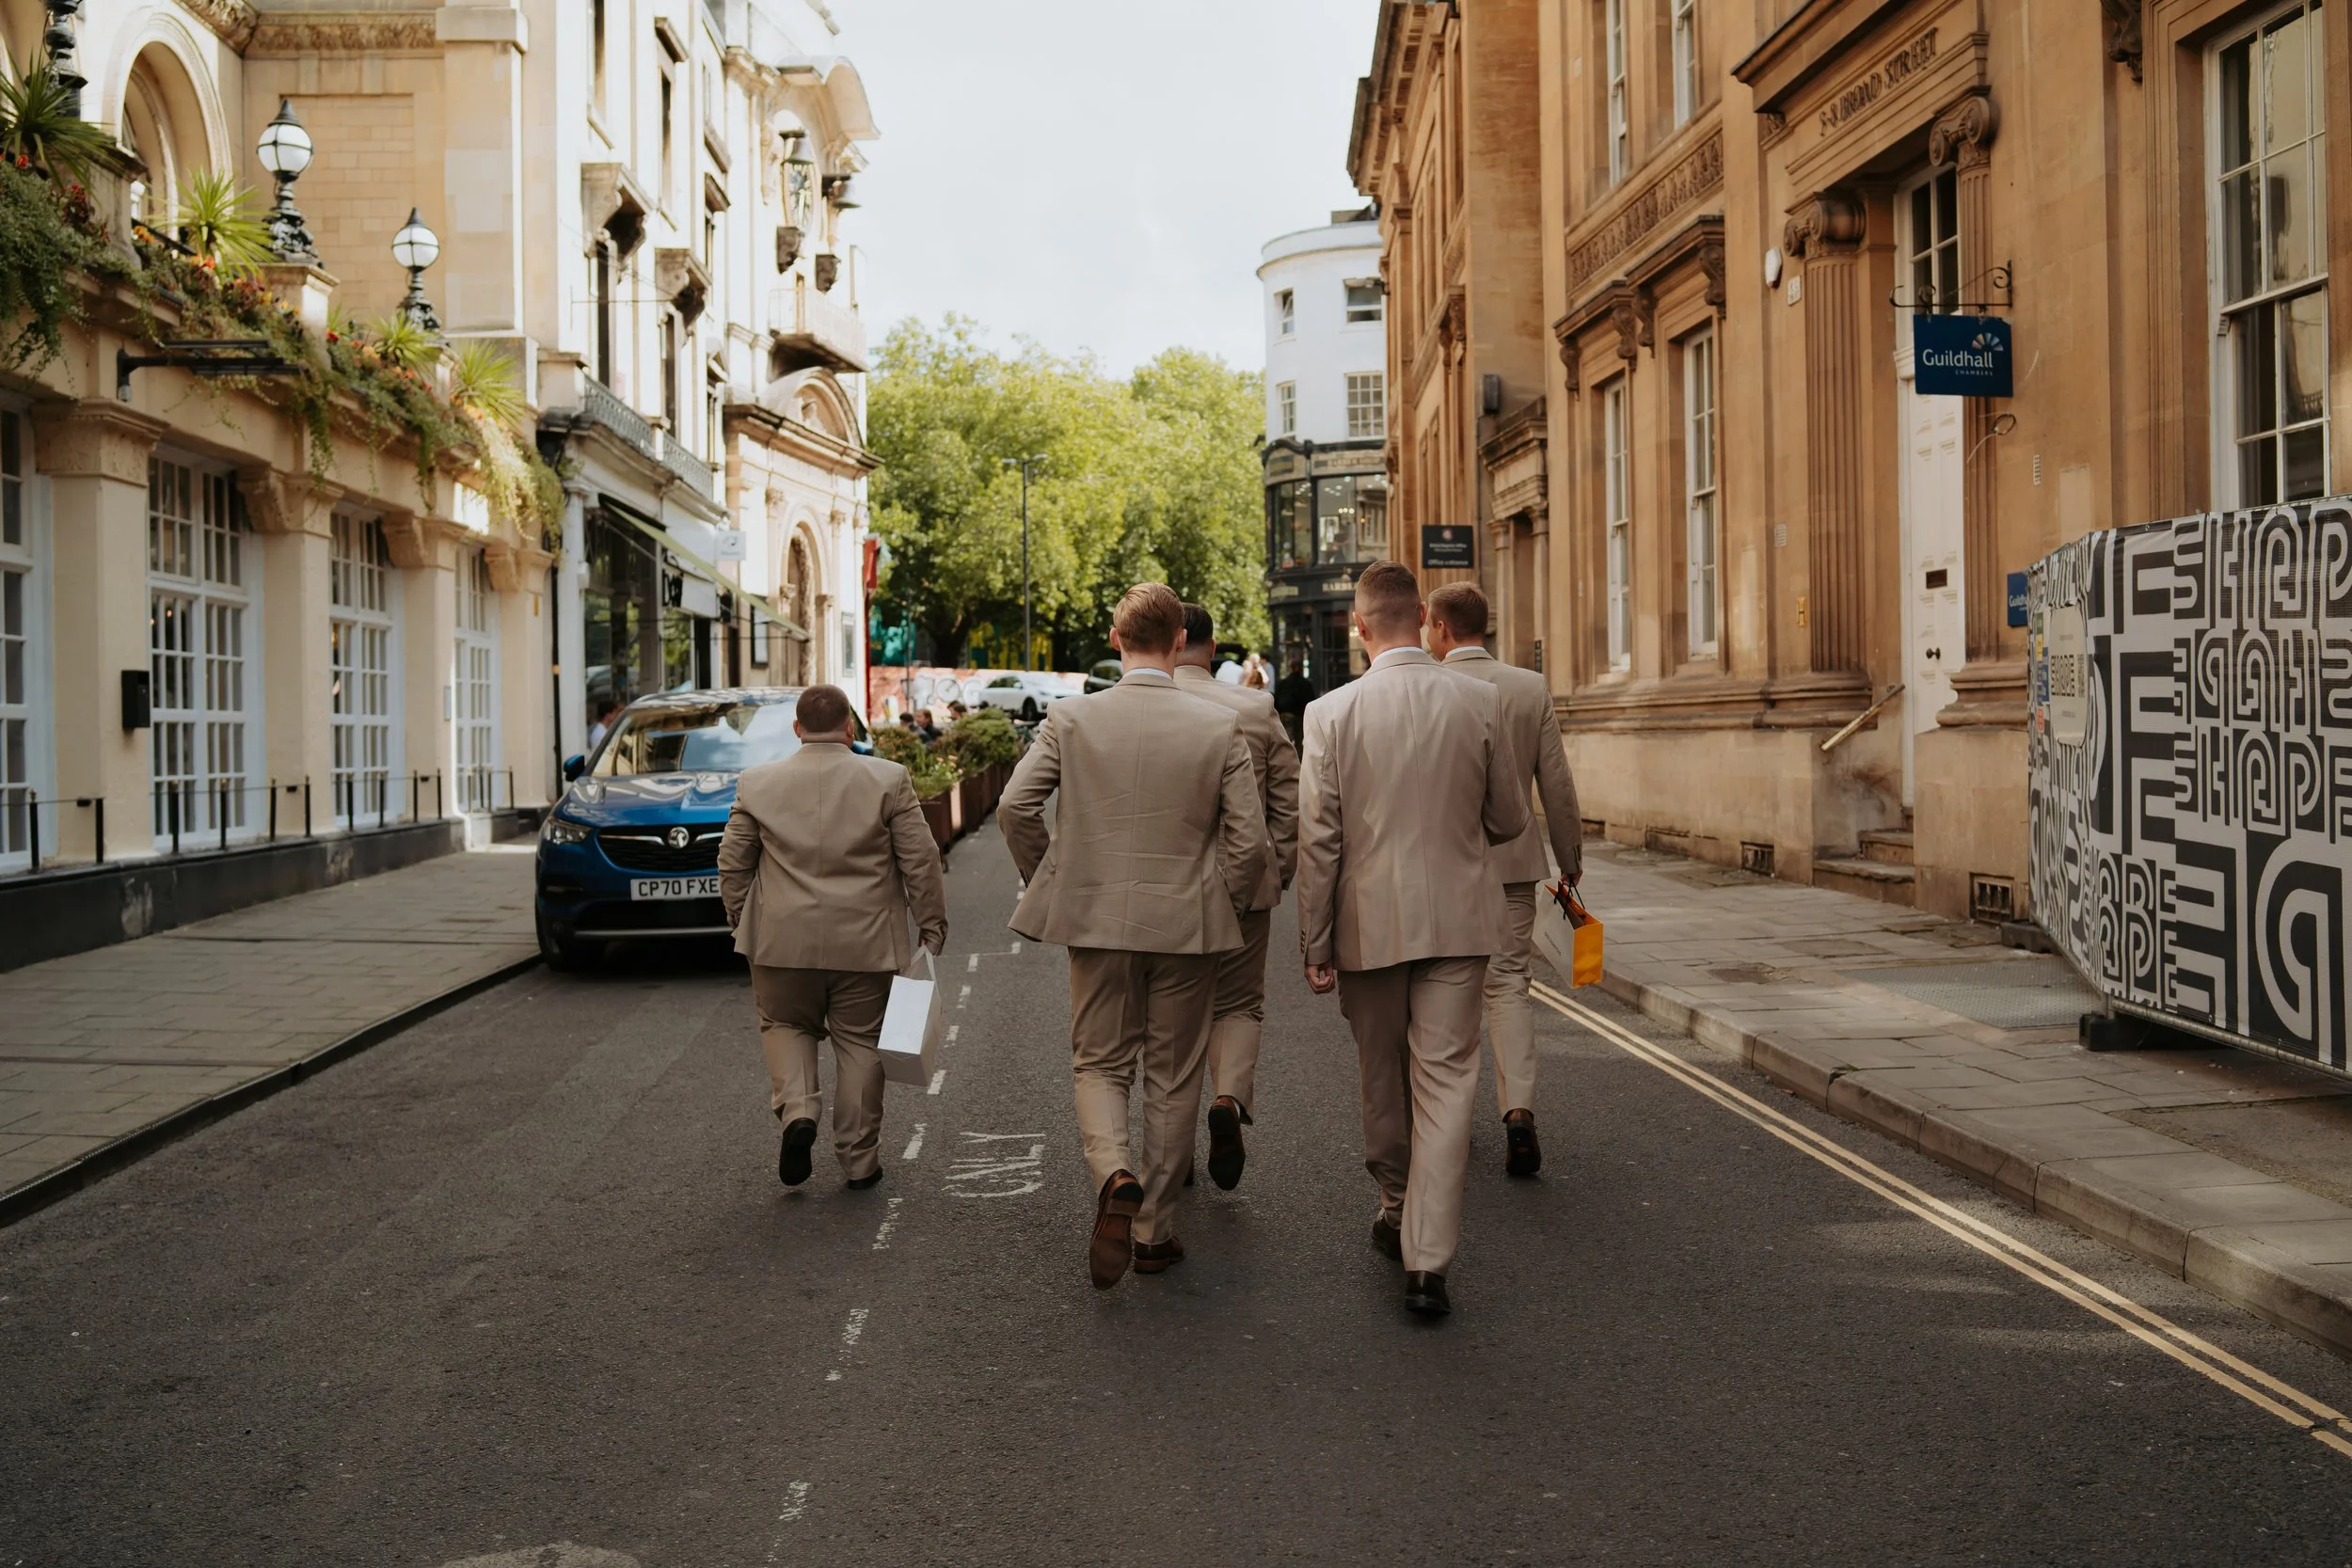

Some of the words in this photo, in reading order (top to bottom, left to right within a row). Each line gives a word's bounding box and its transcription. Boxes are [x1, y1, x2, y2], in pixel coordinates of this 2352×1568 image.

[1839, 71, 1883, 122] BROAD
[1884, 26, 1939, 89] STREET
[1922, 349, 1994, 368] Guildhall
[638, 880, 682, 896] CP70
[687, 878, 719, 895] FXE
